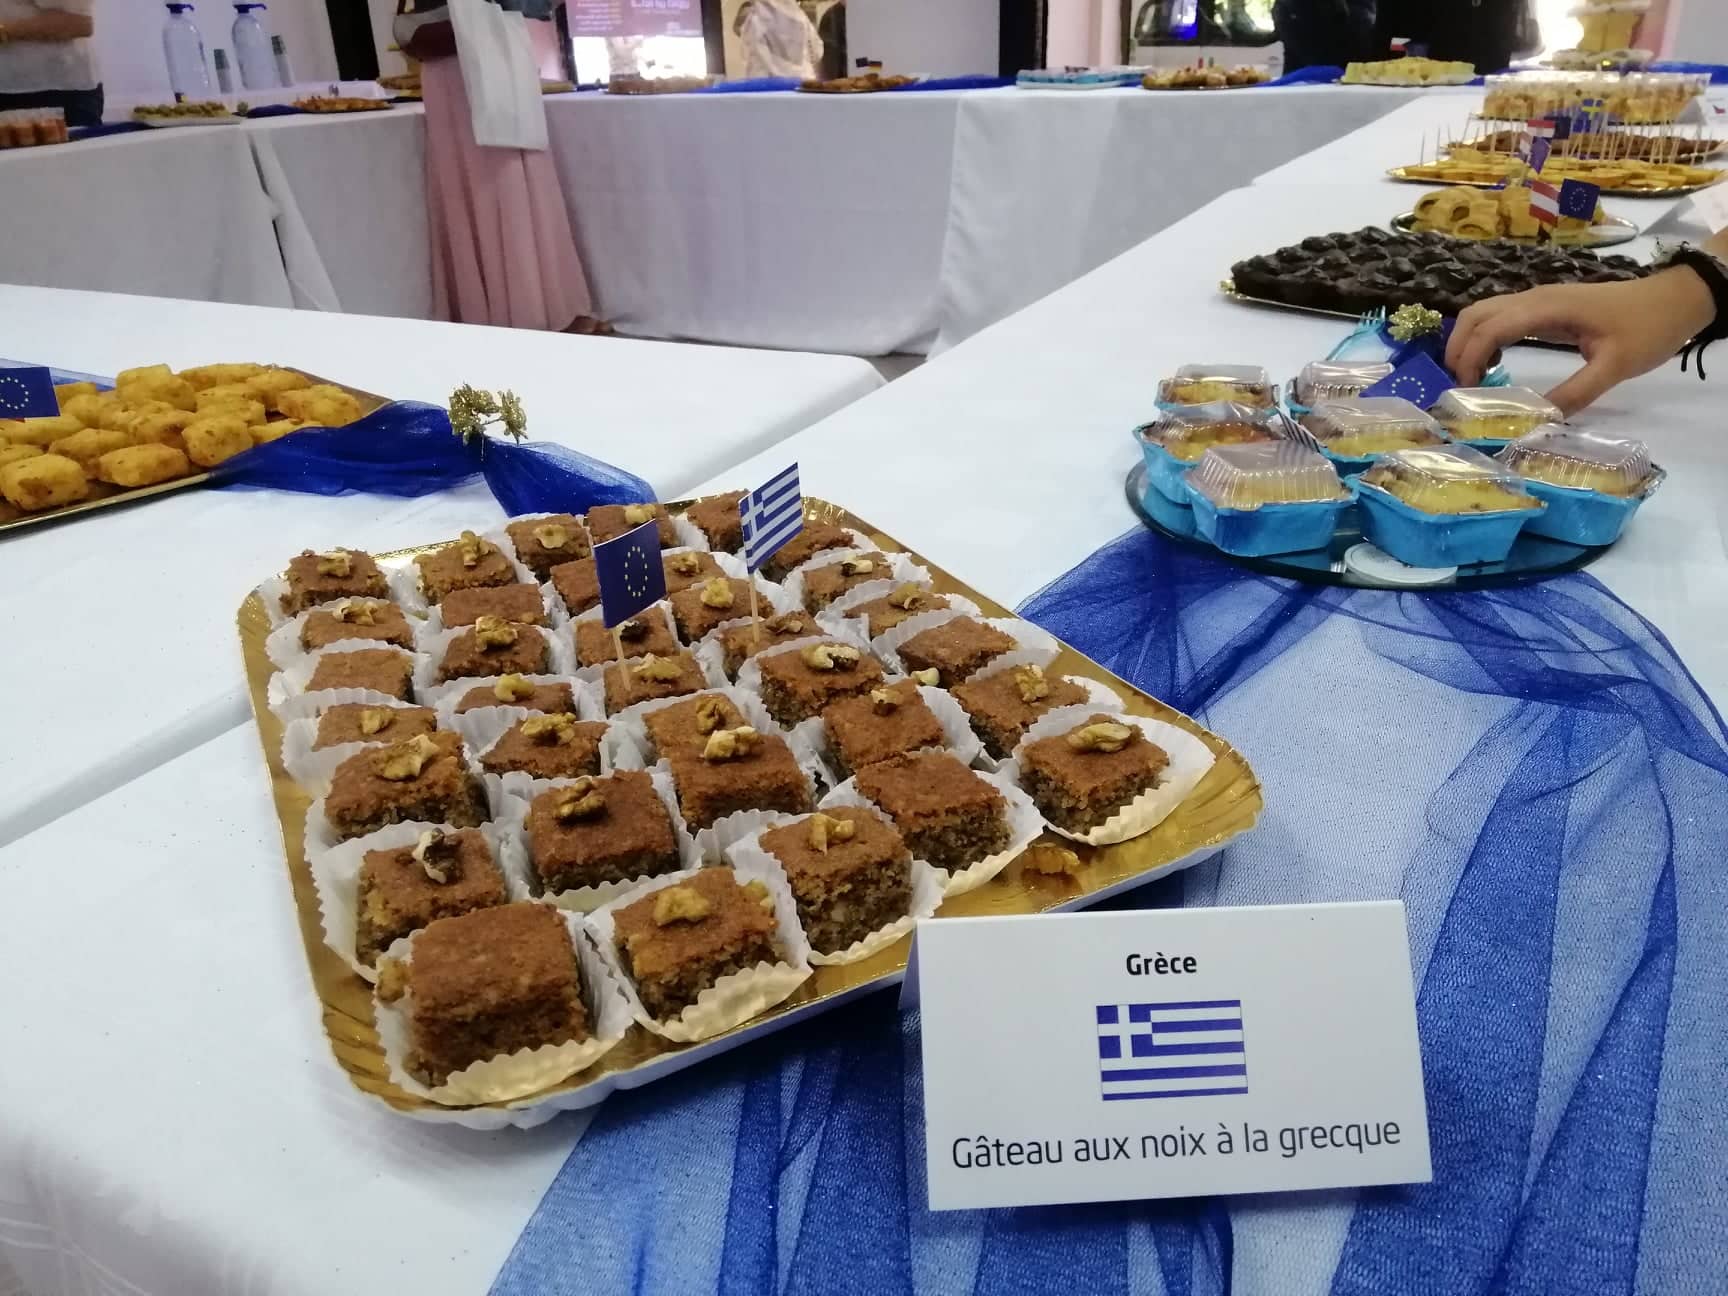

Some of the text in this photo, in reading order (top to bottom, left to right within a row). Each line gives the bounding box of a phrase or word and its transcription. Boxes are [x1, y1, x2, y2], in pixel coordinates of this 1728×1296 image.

[1126, 951, 1197, 976] Grèce
[952, 1121, 1401, 1169] Gâteau aux noix à la grecque
